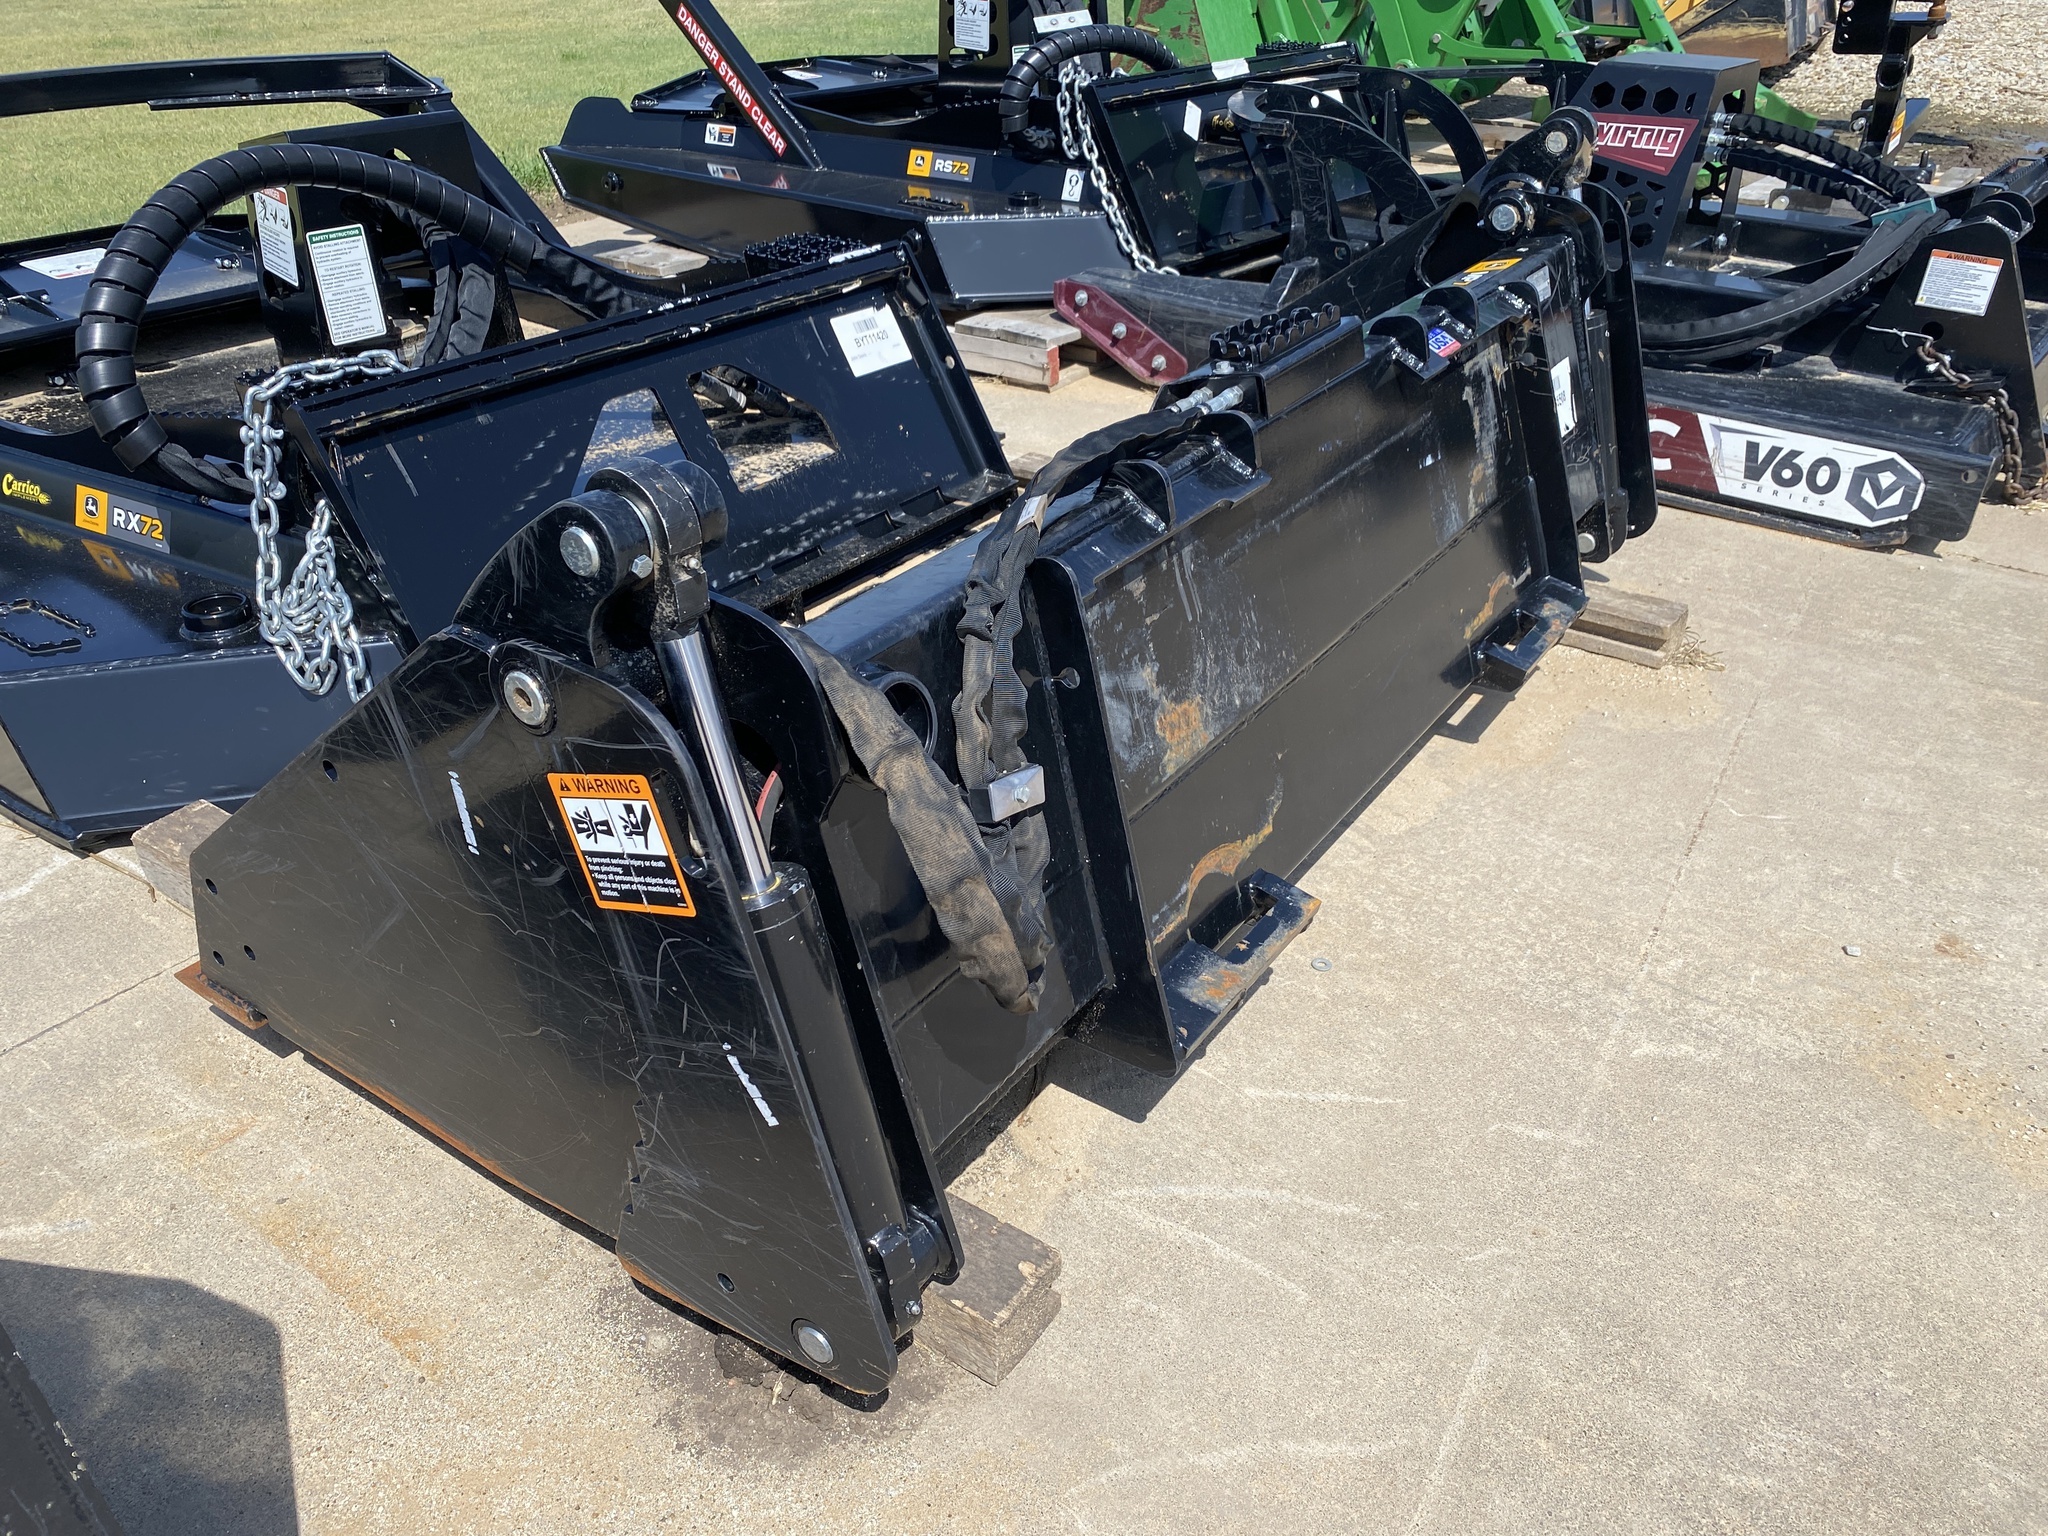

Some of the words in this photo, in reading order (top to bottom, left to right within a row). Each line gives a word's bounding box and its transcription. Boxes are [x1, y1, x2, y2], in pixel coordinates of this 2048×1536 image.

[677, 6, 720, 66] DANGER
[718, 61, 752, 108] STAND
[750, 107, 786, 154] CLEAR
[934, 158, 970, 176] RS72
[312, 234, 329, 242] SAFETY
[329, 229, 360, 240] INSTRUCTIONS
[1953, 254, 1988, 264] WARNING
[854, 329, 889, 348] BYT11420
[1430, 333, 1454, 350] USA
[1743, 440, 1842, 496] V60
[2, 472, 41, 496] Carrico
[1741, 482, 1826, 507] SERIES
[112, 505, 165, 542] RX72
[571, 777, 642, 795] WARNING
[585, 855, 592, 863] To
[592, 857, 611, 865] prevent
[630, 859, 645, 867] injury
[611, 882, 621, 890] any
[621, 883, 631, 891] part
[637, 883, 647, 891] this
[647, 885, 669, 893] machine
[614, 874, 634, 883] persons
[634, 875, 645, 883] and
[645, 876, 664, 885] objects
[601, 889, 621, 897] motion.
